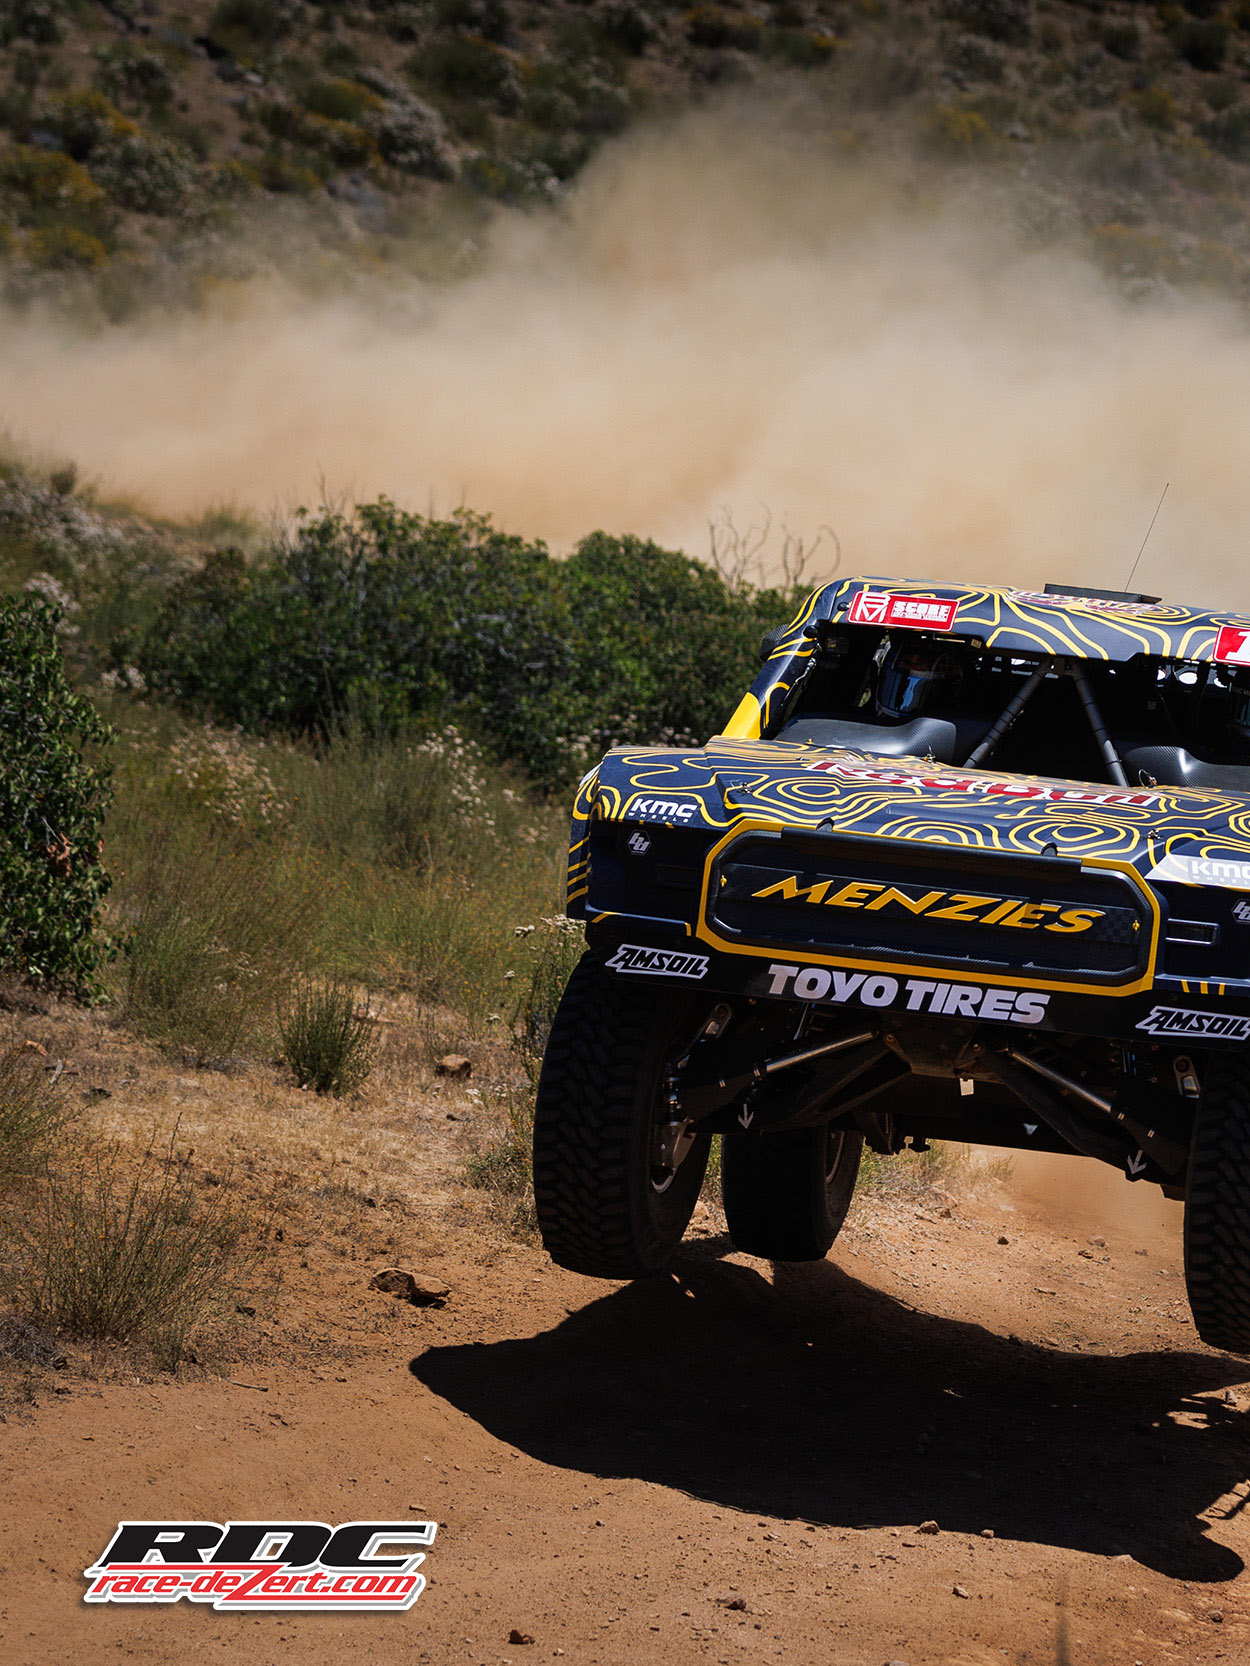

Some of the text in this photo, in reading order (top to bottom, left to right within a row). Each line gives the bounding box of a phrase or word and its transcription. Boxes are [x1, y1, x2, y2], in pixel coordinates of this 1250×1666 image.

[893, 600, 952, 618] SCORE
[752, 875, 1107, 933] MENZIES
[605, 944, 710, 979] AMSOIL
[768, 964, 1051, 1024] TOYO TIRES
